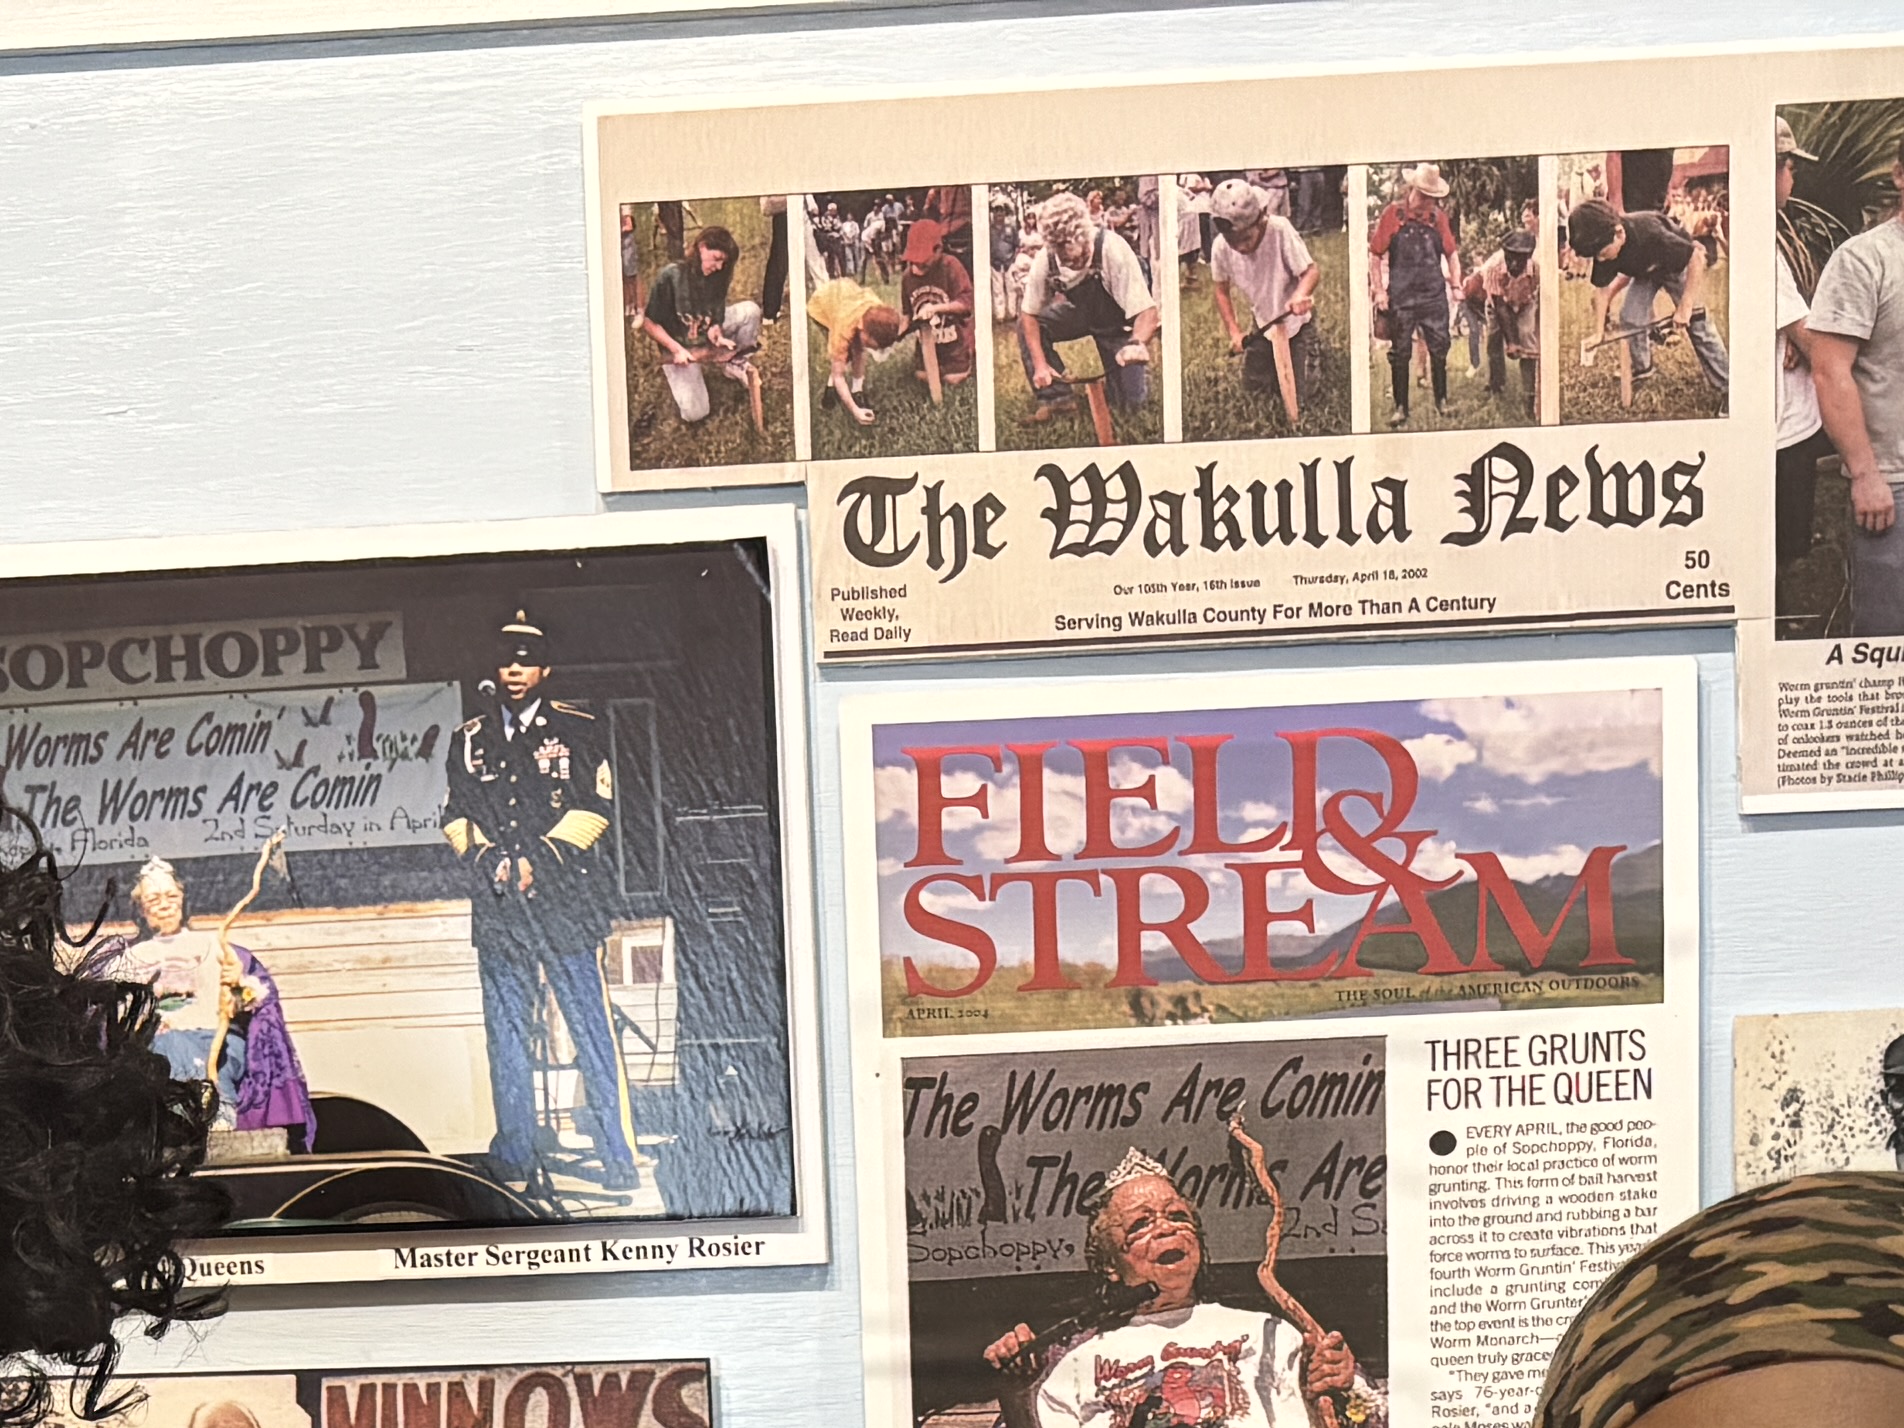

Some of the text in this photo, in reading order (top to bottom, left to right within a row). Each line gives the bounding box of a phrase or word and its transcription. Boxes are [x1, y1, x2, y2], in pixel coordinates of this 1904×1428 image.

[837, 442, 1706, 583] The Wakulla News
[1684, 549, 1710, 570] 50
[1113, 578, 1261, 596] Our 105th Year, 16th Issue
[1292, 567, 1428, 586] Thursday, April 18, 2002
[830, 583, 907, 602] Published
[1665, 579, 1730, 600] Cents
[840, 605, 899, 623] Weekly,
[1054, 595, 1497, 632] Serving Wakulla County For More Than A Century
[829, 625, 912, 643] Read Daily
[1825, 643, 1844, 666] A
[1, 721, 104, 772] Worms
[117, 716, 176, 761] Are
[901, 727, 1465, 896] FIELD &
[202, 818, 247, 844] 2nd
[362, 815, 383, 833] in
[903, 845, 1638, 999] STREAM
[1335, 976, 1640, 1002] THE SOUL AMERICAN OUTDOORS
[906, 1008, 954, 1020] APRIL
[1424, 1028, 1646, 1072] THREE GRUNTS
[1427, 1067, 1652, 1112] FOR THE QUEEN
[1429, 1205, 1658, 1228] into the ground and rubbing a bar
[394, 1237, 766, 1270] Master Sergeant Kenny Rosier
